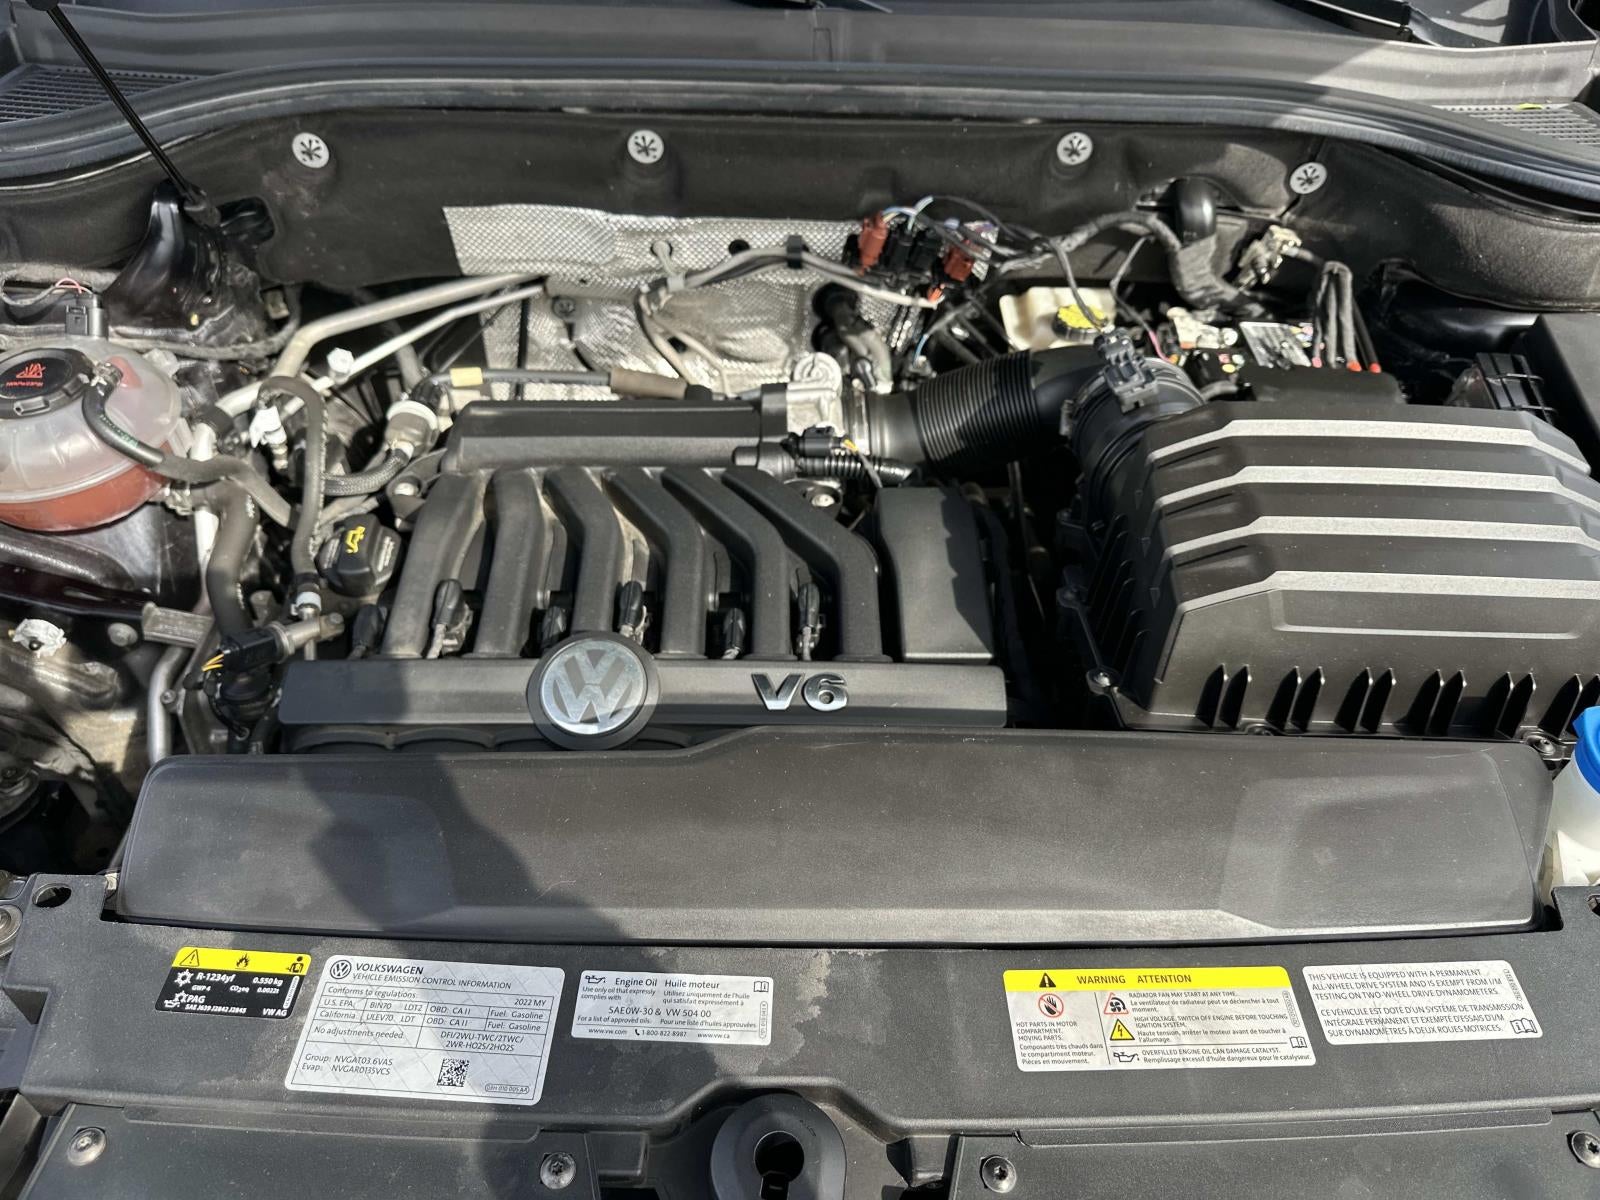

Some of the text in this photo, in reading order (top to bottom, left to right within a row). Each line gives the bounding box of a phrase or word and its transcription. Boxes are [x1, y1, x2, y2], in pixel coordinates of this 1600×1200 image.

[750, 672, 848, 711] V6
[356, 963, 423, 974] VOLKSWAGEN
[196, 972, 236, 982] R-1234yf
[1077, 974, 1192, 984] WARNING ATTENTION
[384, 975, 420, 983] EMISSION
[421, 977, 456, 986] CONTROL
[458, 980, 511, 989] INFORMATION
[615, 978, 657, 988] Engine Oil
[665, 980, 687, 988] Huile
[328, 986, 364, 995] Conforms
[1362, 991, 1410, 999] TWO-WHEEL
[1470, 1003, 1524, 1012] TRANSMISSION
[320, 1010, 356, 1018] California
[512, 1011, 543, 1019] Gasoline
[1365, 1017, 1409, 1025] PERMANENT
[509, 1023, 540, 1031] Gasoline
[1415, 1025, 1435, 1034] DEUX
[326, 1027, 374, 1037] adjustments
[305, 1053, 331, 1062] Group:
[302, 1063, 322, 1071] Evap:
